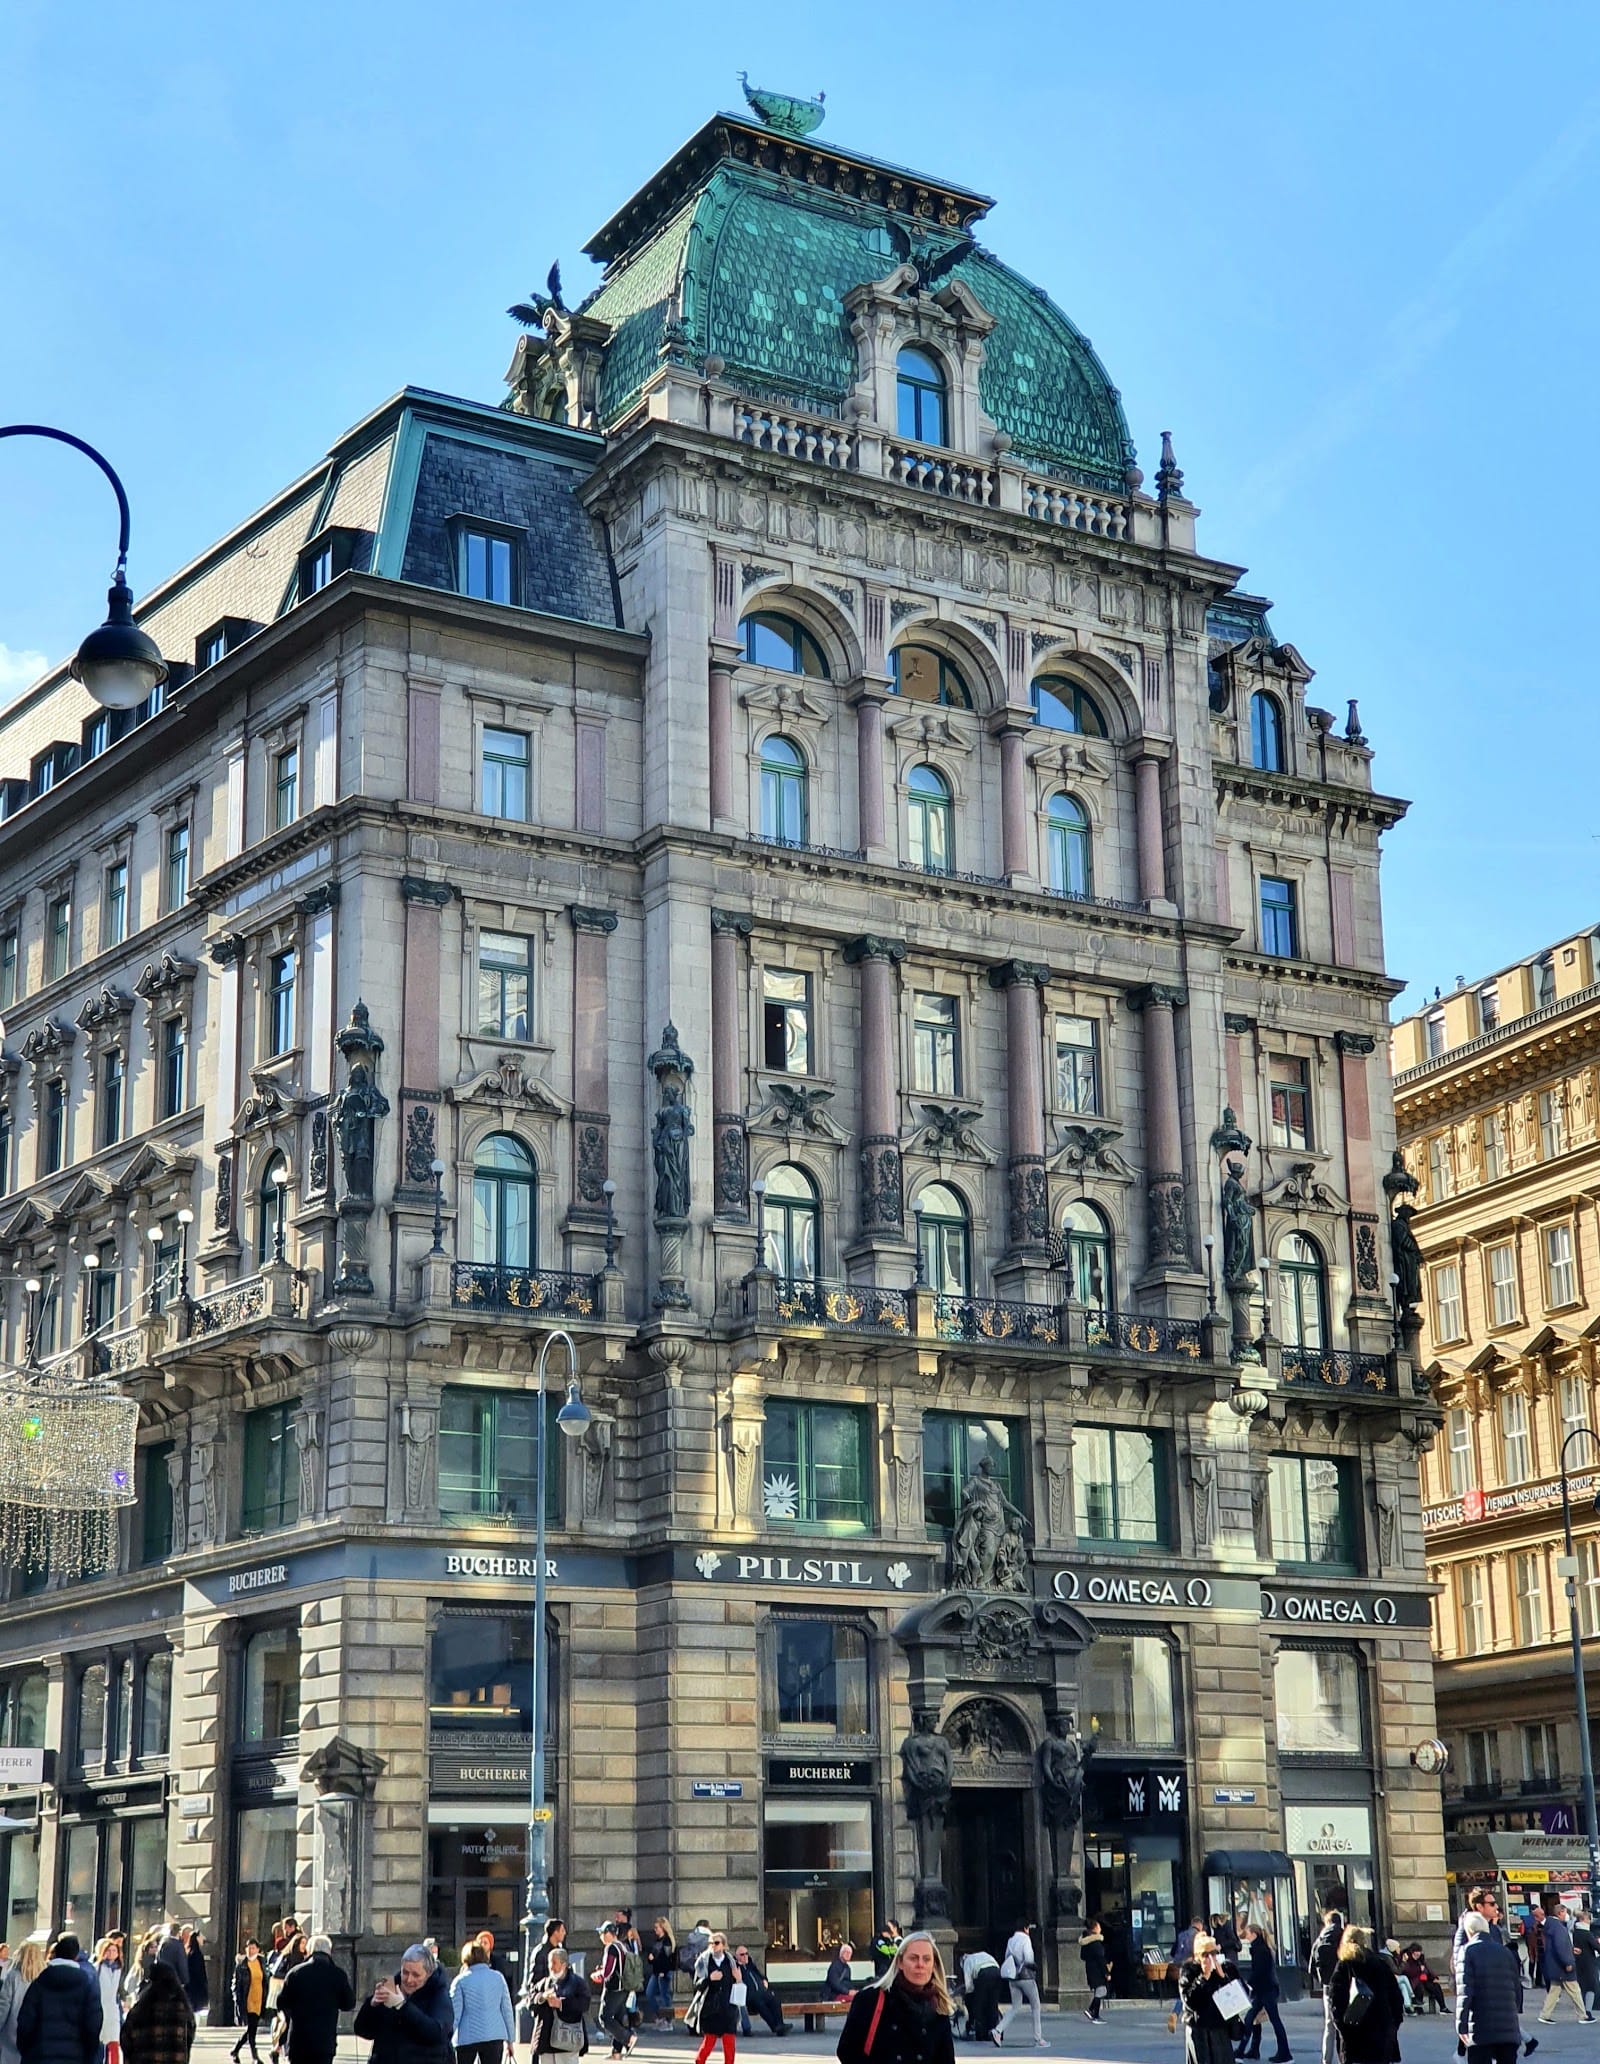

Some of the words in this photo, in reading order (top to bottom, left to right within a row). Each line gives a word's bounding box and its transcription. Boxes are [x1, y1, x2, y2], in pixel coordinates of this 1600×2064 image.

[1484, 1494, 1515, 1511] VIENNA
[1515, 1482, 1563, 1503] INSURANCE
[229, 1564, 286, 1592] BUCHERER
[736, 1555, 873, 1585] PILSTL
[1088, 1577, 1179, 1605] OMEGA
[1284, 1597, 1367, 1622] OMEGA
[459, 1768, 528, 1780] BUCHERER
[789, 1767, 852, 1780] BUCHERER
[461, 1844, 485, 1855] PATEK
[1308, 1839, 1353, 1851] OMEGA
[1521, 1837, 1562, 1847] WIENER
